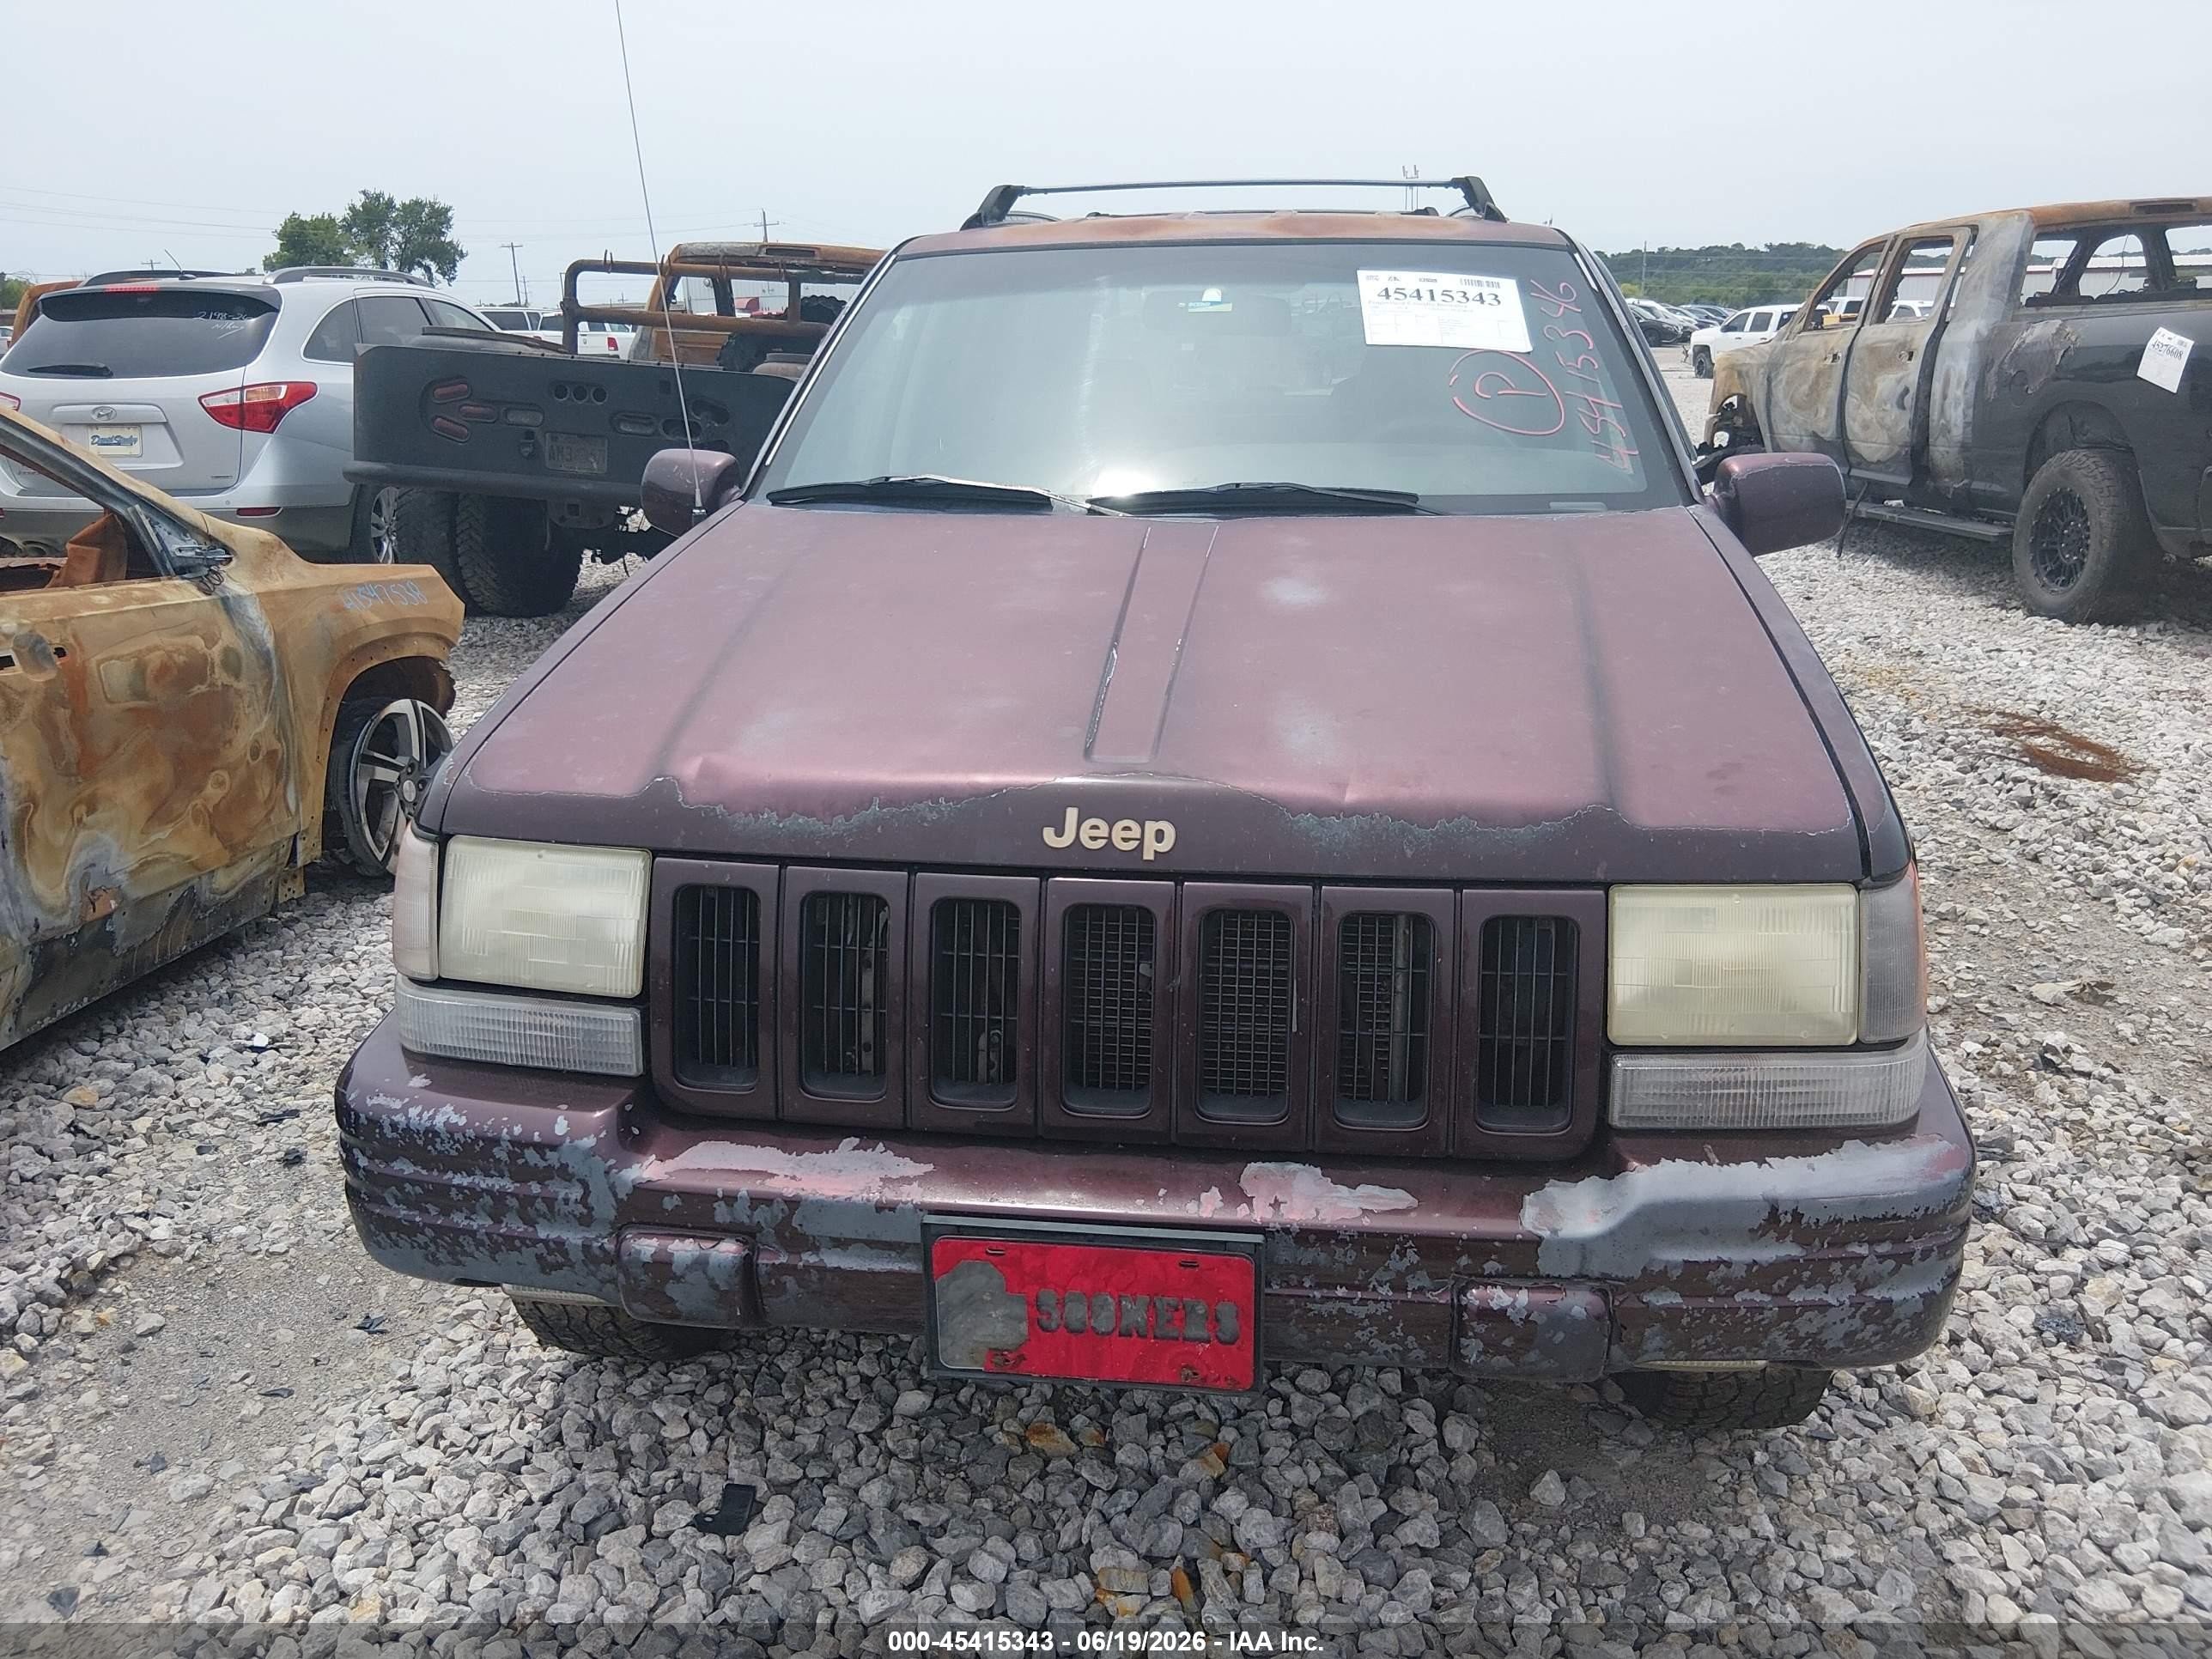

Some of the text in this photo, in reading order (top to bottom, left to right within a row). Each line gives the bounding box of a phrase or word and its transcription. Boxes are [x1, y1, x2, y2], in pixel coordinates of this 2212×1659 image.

[1376, 287, 1501, 307] 45415343
[2151, 339, 2184, 361] 45276608
[1042, 806, 1176, 860] Jeep
[1036, 1288, 1240, 1346] SOONERS
